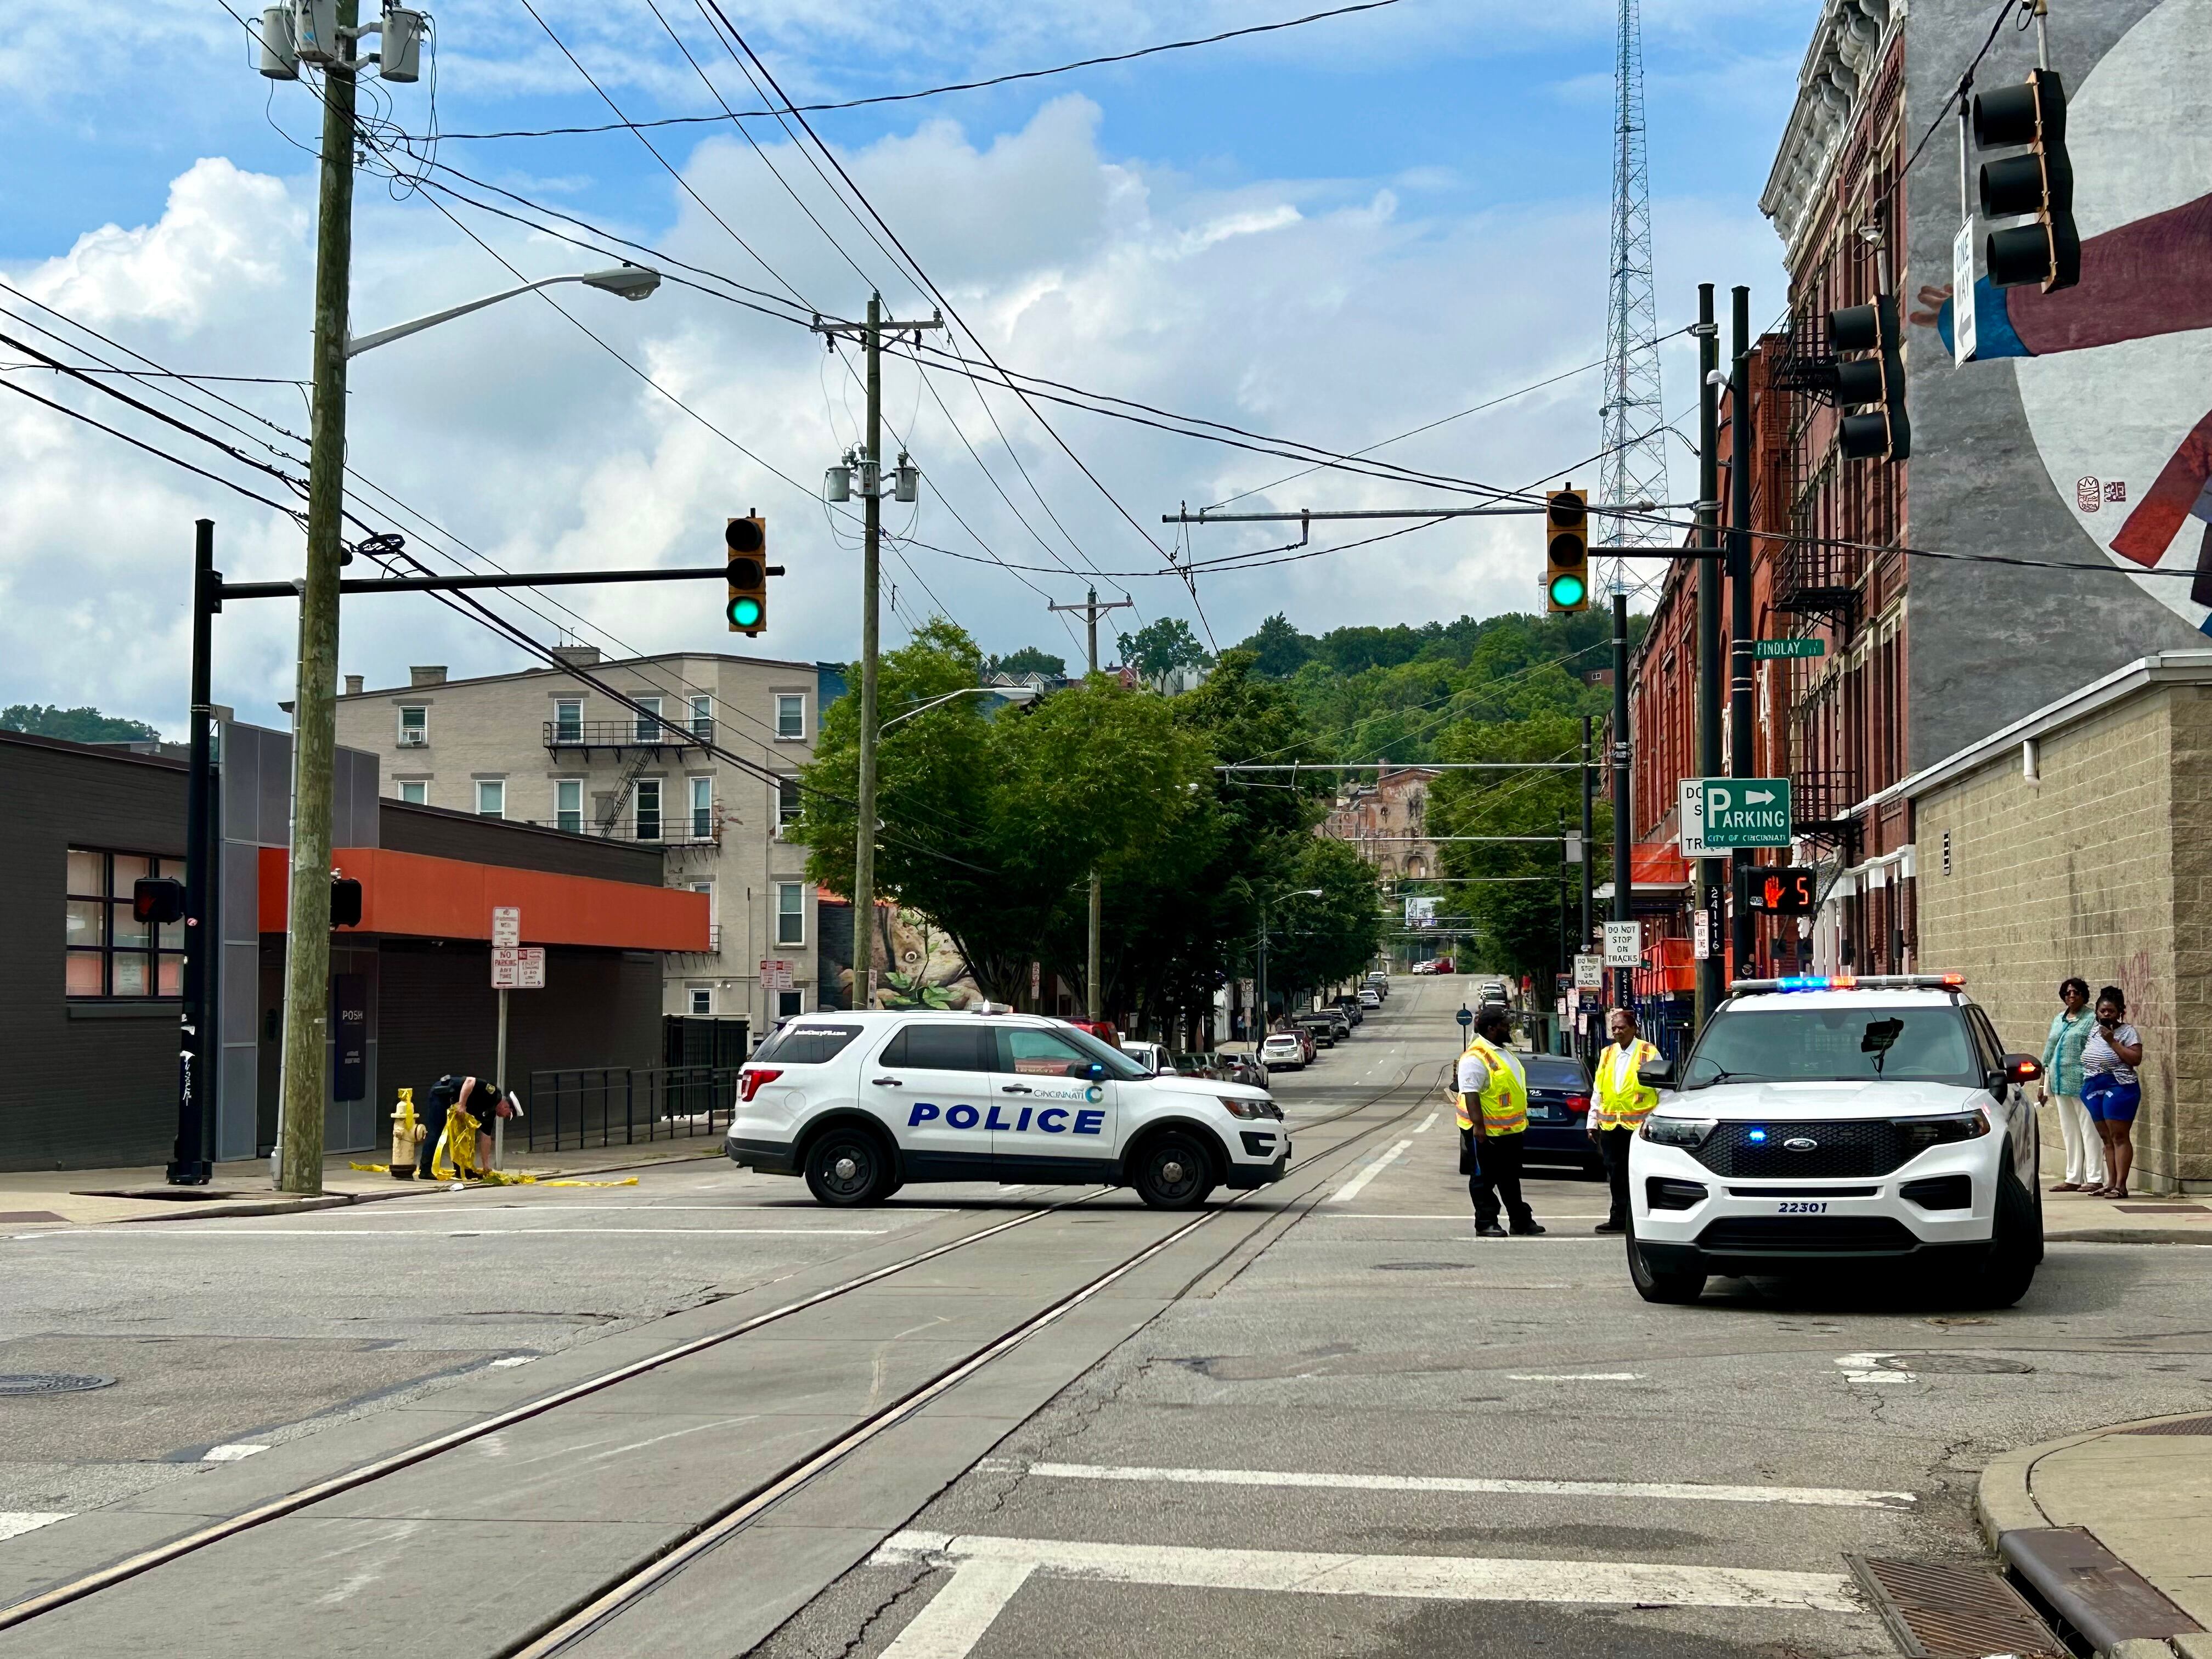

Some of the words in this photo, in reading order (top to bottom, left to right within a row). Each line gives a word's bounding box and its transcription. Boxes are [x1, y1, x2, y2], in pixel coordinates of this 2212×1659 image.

[1956, 232, 1970, 273] ONE
[1757, 641, 1801, 655] FINDLAY
[1708, 788, 1785, 828] PARKING
[1796, 877, 1808, 905] 5
[1621, 925, 1636, 933] NOT
[1034, 1090, 1084, 1099] CINCINNATI
[907, 1103, 1105, 1134] POLICE
[1778, 1203, 1827, 1213] 22301
